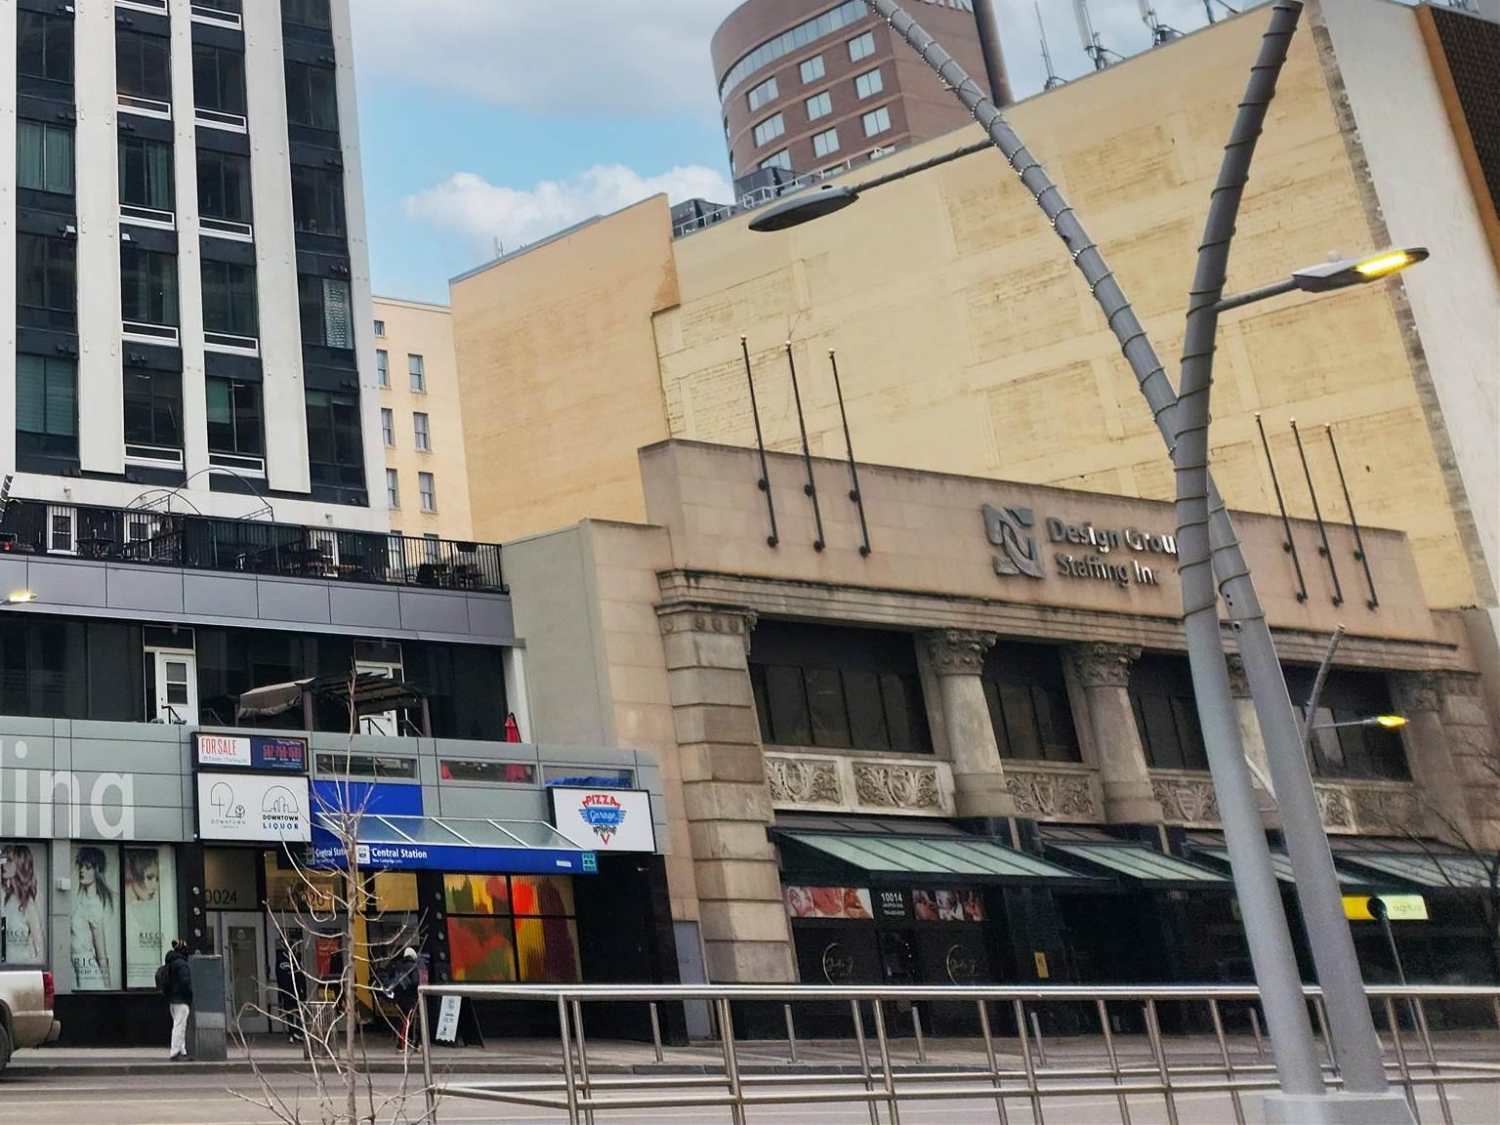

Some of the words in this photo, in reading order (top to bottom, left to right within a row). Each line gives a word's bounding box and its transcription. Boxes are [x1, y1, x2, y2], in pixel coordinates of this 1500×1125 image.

[1046, 517, 1119, 553] Design
[1124, 526, 1179, 555] Grou
[1056, 554, 1129, 586] Staffing
[201, 737, 216, 755] FOR
[217, 738, 237, 756] SALE
[586, 794, 618, 806] PIZZA
[262, 822, 299, 830] LIQUOR
[372, 847, 399, 858] Central
[400, 848, 428, 859] Station
[880, 892, 903, 903] 10014
